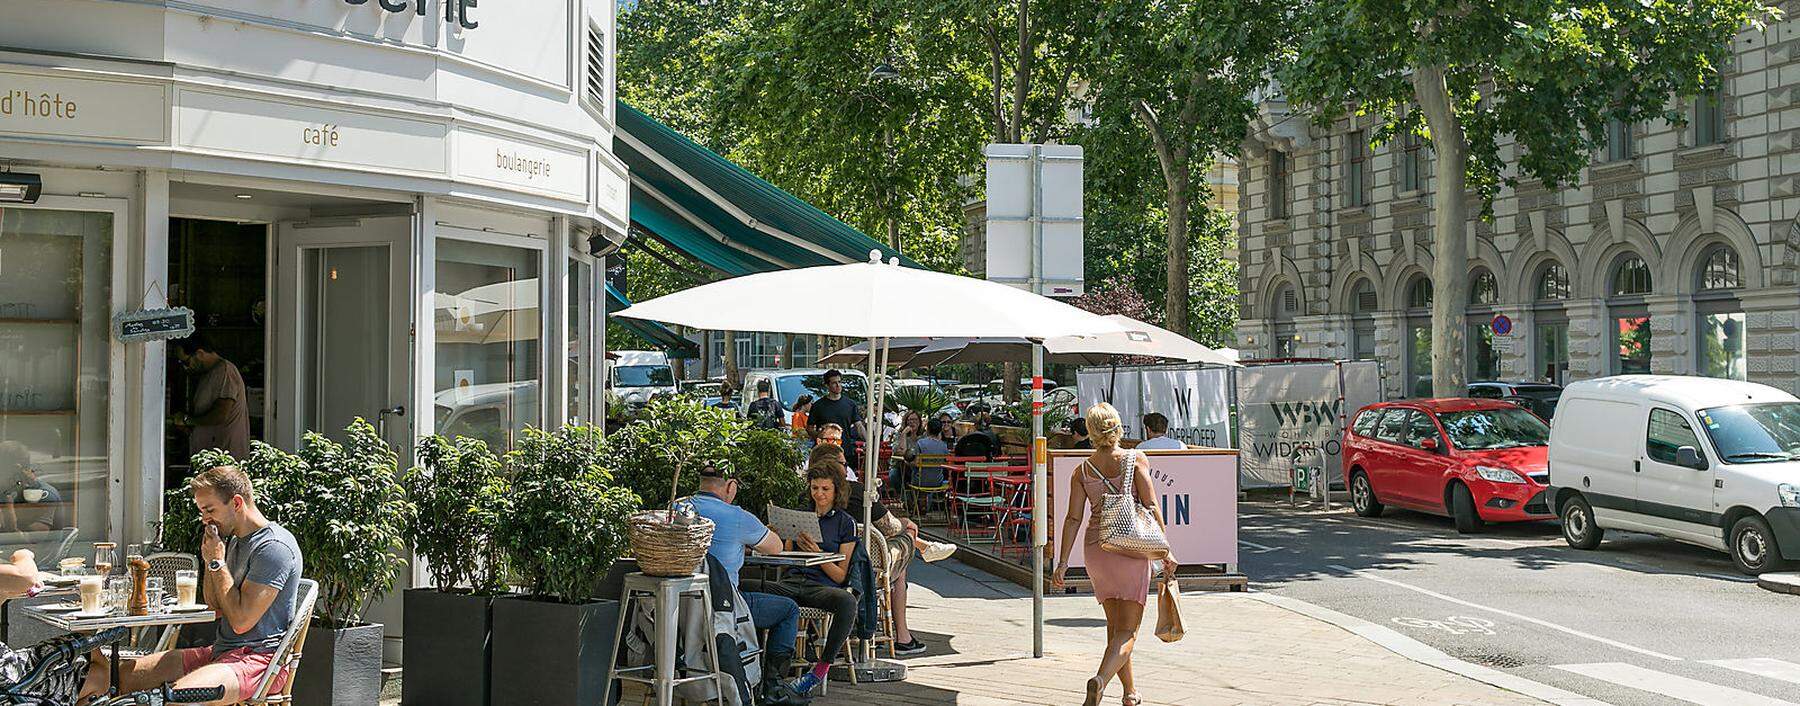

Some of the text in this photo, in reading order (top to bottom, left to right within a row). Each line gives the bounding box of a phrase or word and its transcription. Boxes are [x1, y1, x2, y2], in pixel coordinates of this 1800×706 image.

[1, 91, 77, 119] d'hôte
[303, 123, 339, 147] café
[496, 148, 551, 179] boulangerie
[1174, 387, 1192, 420] W
[1167, 427, 1217, 448] IDERHOFER
[1297, 468, 1305, 488] P
[1162, 494, 1189, 525] IN
